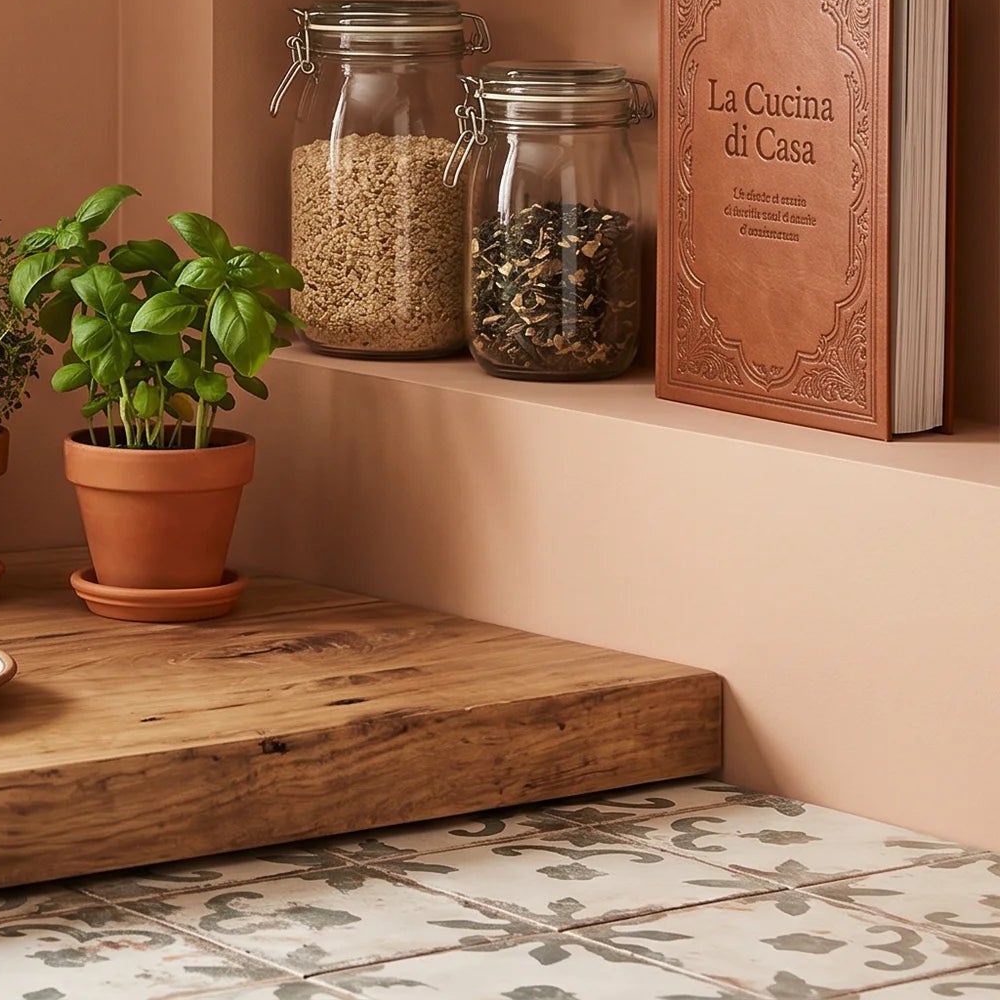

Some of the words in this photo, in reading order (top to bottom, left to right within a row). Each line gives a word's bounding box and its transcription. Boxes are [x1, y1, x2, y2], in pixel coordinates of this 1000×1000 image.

[708, 78, 737, 113] La
[744, 82, 834, 122] Cucina
[725, 122, 748, 158] di
[756, 127, 816, 165] Casa
